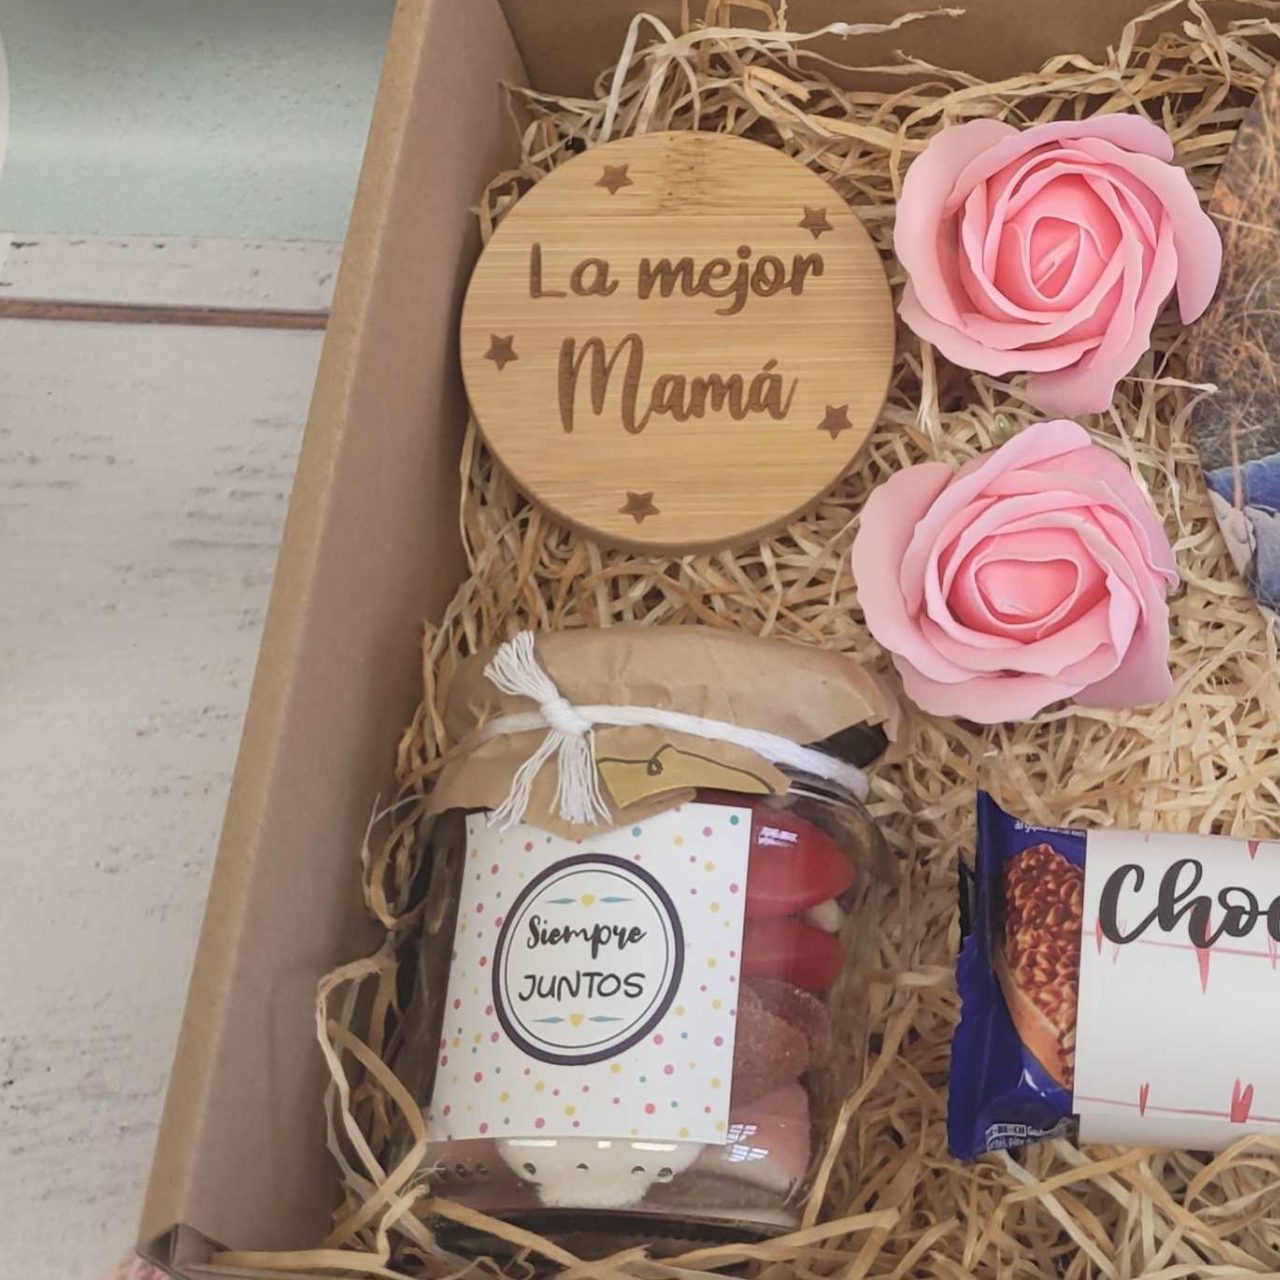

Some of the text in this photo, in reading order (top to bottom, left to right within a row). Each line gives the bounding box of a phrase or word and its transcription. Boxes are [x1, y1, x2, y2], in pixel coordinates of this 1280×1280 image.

[529, 242, 825, 317] La mejor
[558, 332, 799, 436] Mamá
[526, 914, 648, 960] Siempre
[518, 970, 646, 1002] JUNTOS
